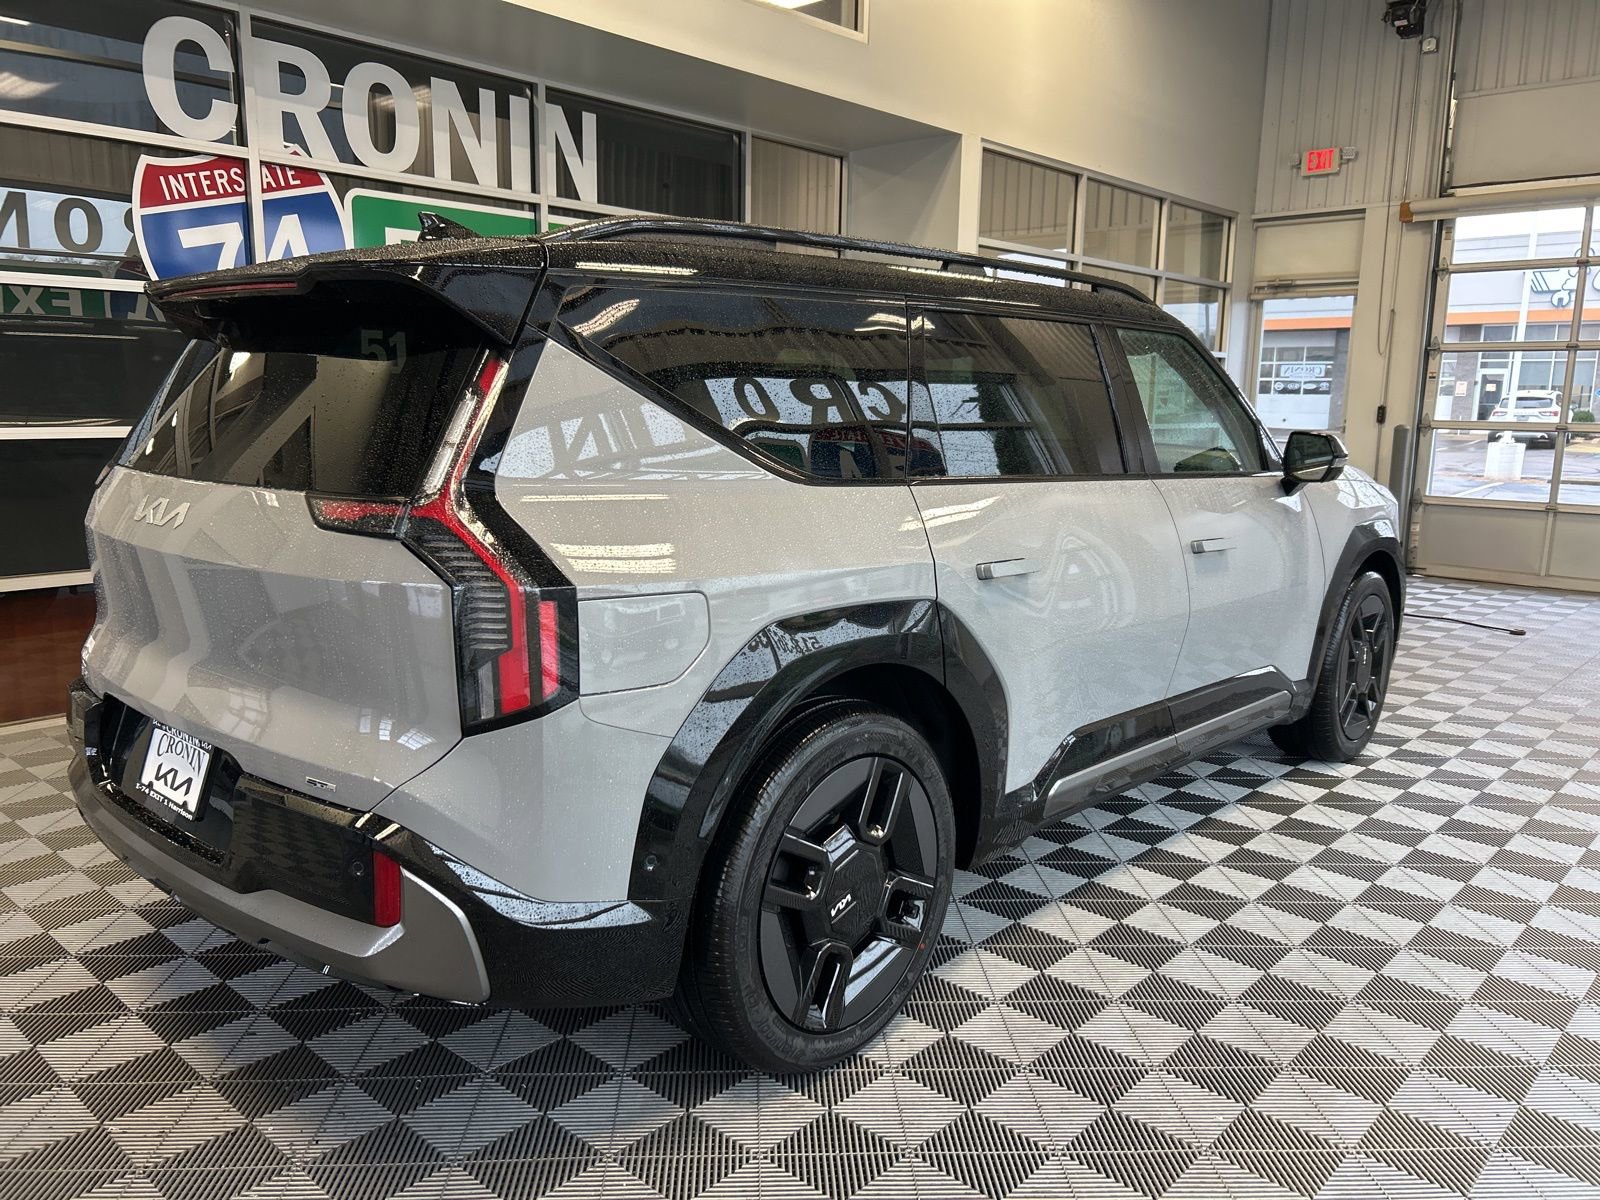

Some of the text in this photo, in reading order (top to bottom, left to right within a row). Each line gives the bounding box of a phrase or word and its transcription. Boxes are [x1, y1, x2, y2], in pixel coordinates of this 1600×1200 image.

[142, 15, 598, 205] CRONIN
[1307, 149, 1335, 172] EXIT
[159, 163, 302, 201] INTERSATE
[134, 494, 190, 529] KIA
[157, 733, 206, 776] CRONIN
[154, 762, 193, 796] KIA
[149, 790, 164, 803] EXIT
[168, 801, 193, 821] Harrison
